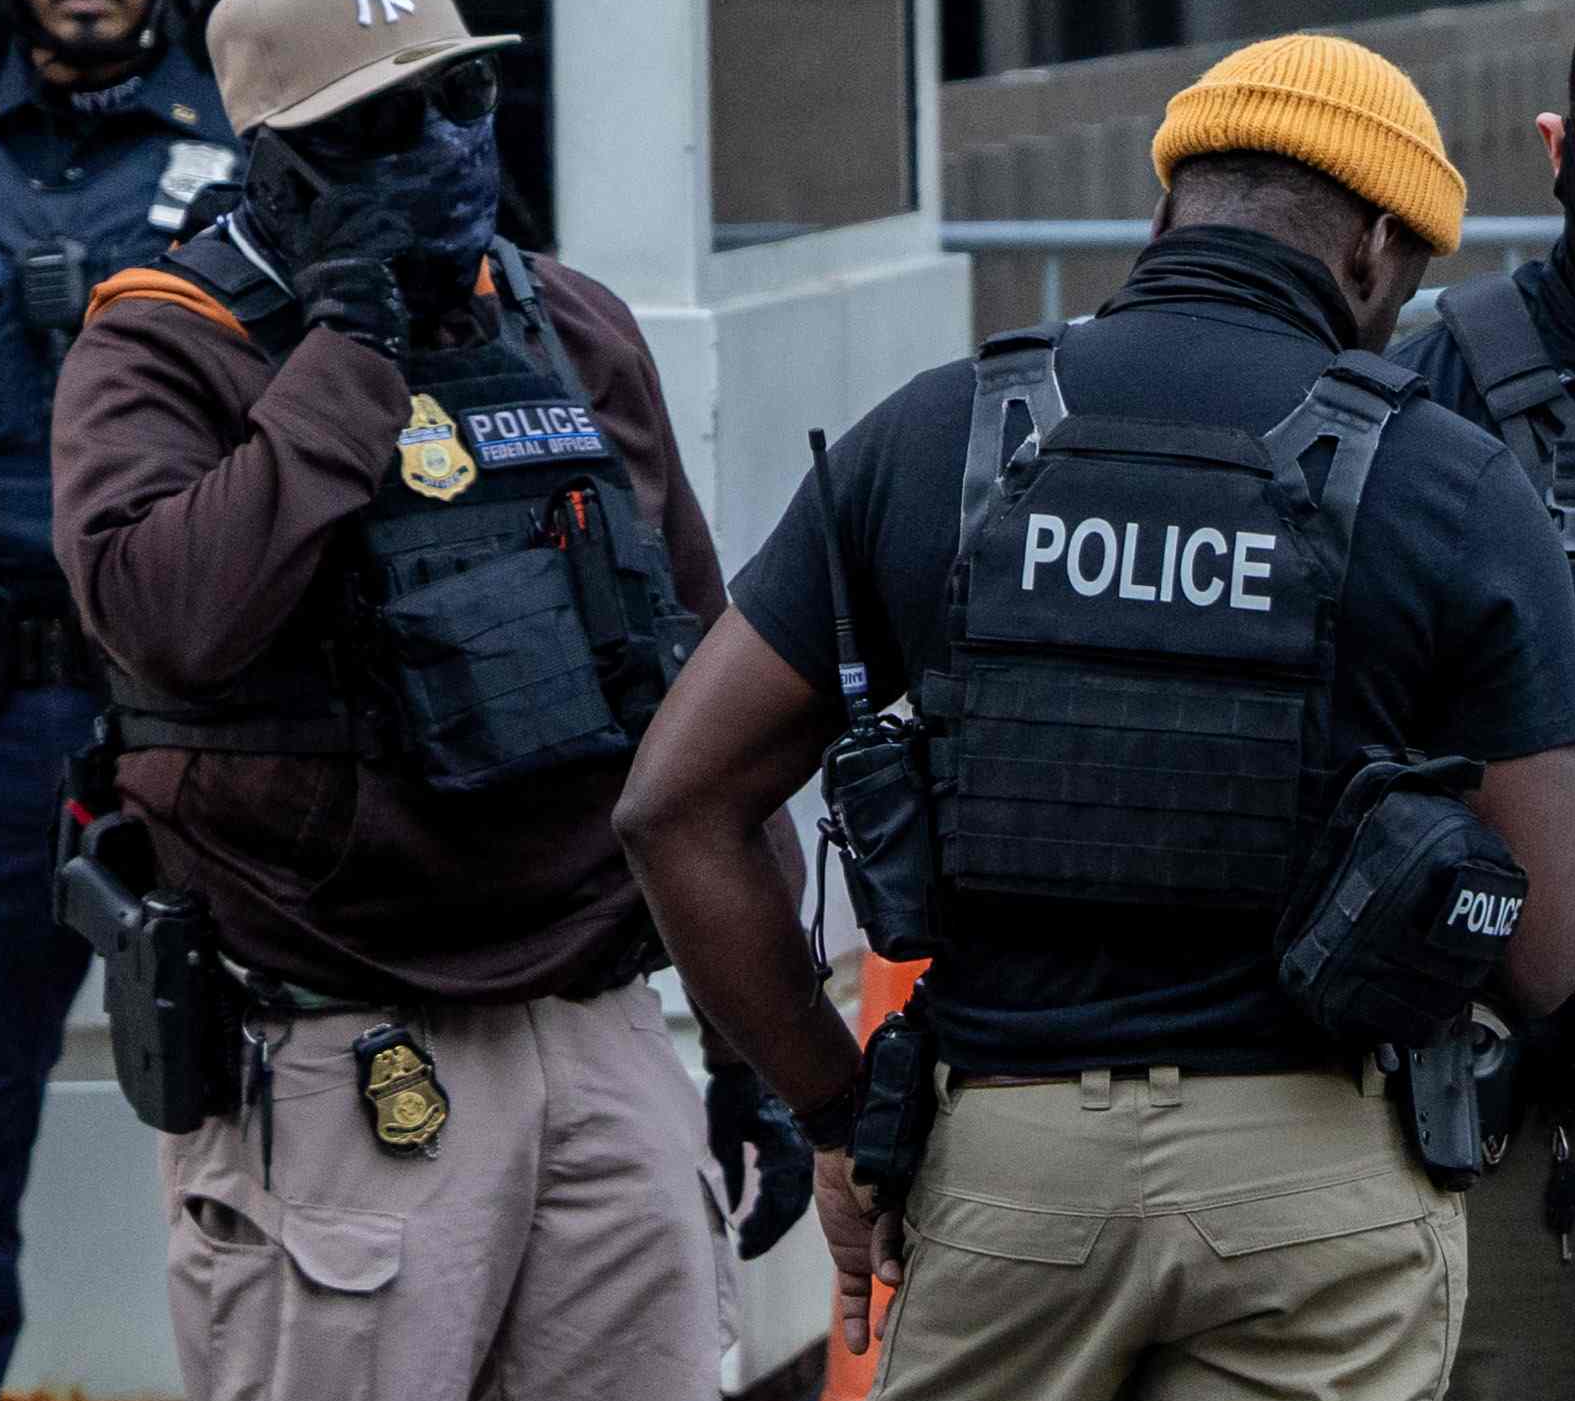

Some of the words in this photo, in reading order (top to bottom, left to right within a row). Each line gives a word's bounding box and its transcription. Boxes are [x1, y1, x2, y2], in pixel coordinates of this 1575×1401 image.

[468, 407, 596, 442] POLICE
[482, 440, 544, 462] FEDERAL
[549, 436, 602, 453] OFFICER
[1021, 513, 1276, 612] POLICE
[1447, 889, 1523, 937] POLICE
